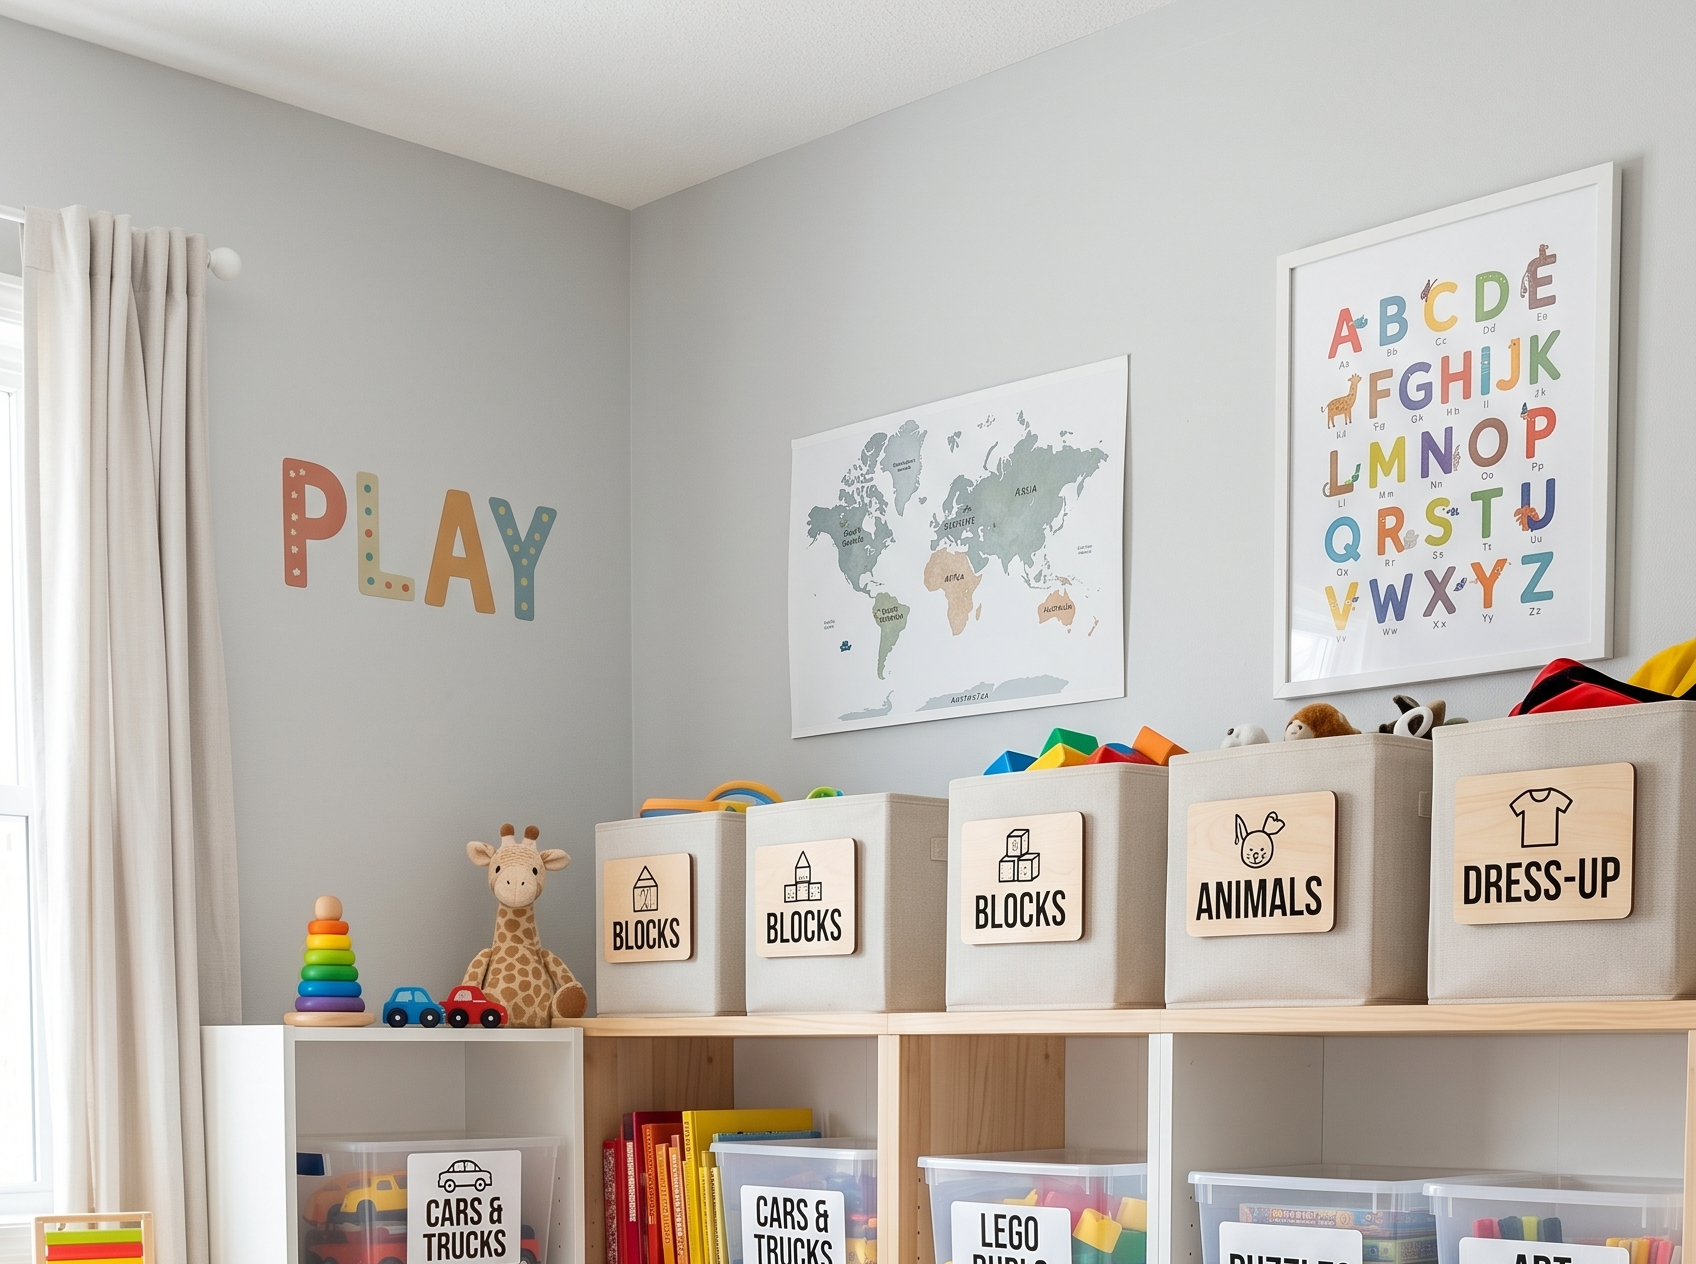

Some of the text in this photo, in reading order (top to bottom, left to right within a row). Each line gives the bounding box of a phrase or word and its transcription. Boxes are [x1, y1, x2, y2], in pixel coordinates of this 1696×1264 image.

[1328, 254, 1556, 359] A B C D E
[1386, 347, 1398, 358] Bb
[1435, 337, 1447, 347] Cc
[1483, 323, 1496, 335] Dd
[1369, 369, 1393, 419] F
[1399, 362, 1433, 411] G
[1441, 351, 1472, 404] H
[1496, 338, 1520, 391] J
[1529, 330, 1561, 385] K
[1330, 407, 1556, 497] L M N O P
[1378, 491, 1394, 499] Mm
[1430, 480, 1443, 490] Nn
[1481, 471, 1494, 481] Oo
[1531, 462, 1544, 472] Pp
[282, 457, 557, 621] PLAY
[1325, 516, 1361, 563] Q
[1377, 506, 1405, 556] R
[1425, 497, 1453, 546] S
[1471, 487, 1503, 538] T
[1384, 558, 1396, 567] Rr
[1530, 535, 1543, 544] Uu
[1325, 551, 1553, 630] V W X Y Z
[1382, 627, 1398, 636] Ww
[1432, 620, 1447, 630] Xx
[1481, 613, 1494, 624] Yy
[1196, 876, 1322, 920] ANIMALS
[1464, 857, 1620, 904] DRESS-UP
[767, 909, 841, 943] BLOCKS
[976, 890, 1065, 929] BLOCKS
[613, 918, 679, 950] BLOCKS
[427, 1197, 502, 1227] CARS &
[757, 1196, 828, 1233] CARS &
[423, 1229, 506, 1261] TRUCKS
[981, 1213, 1038, 1251] LEGO
